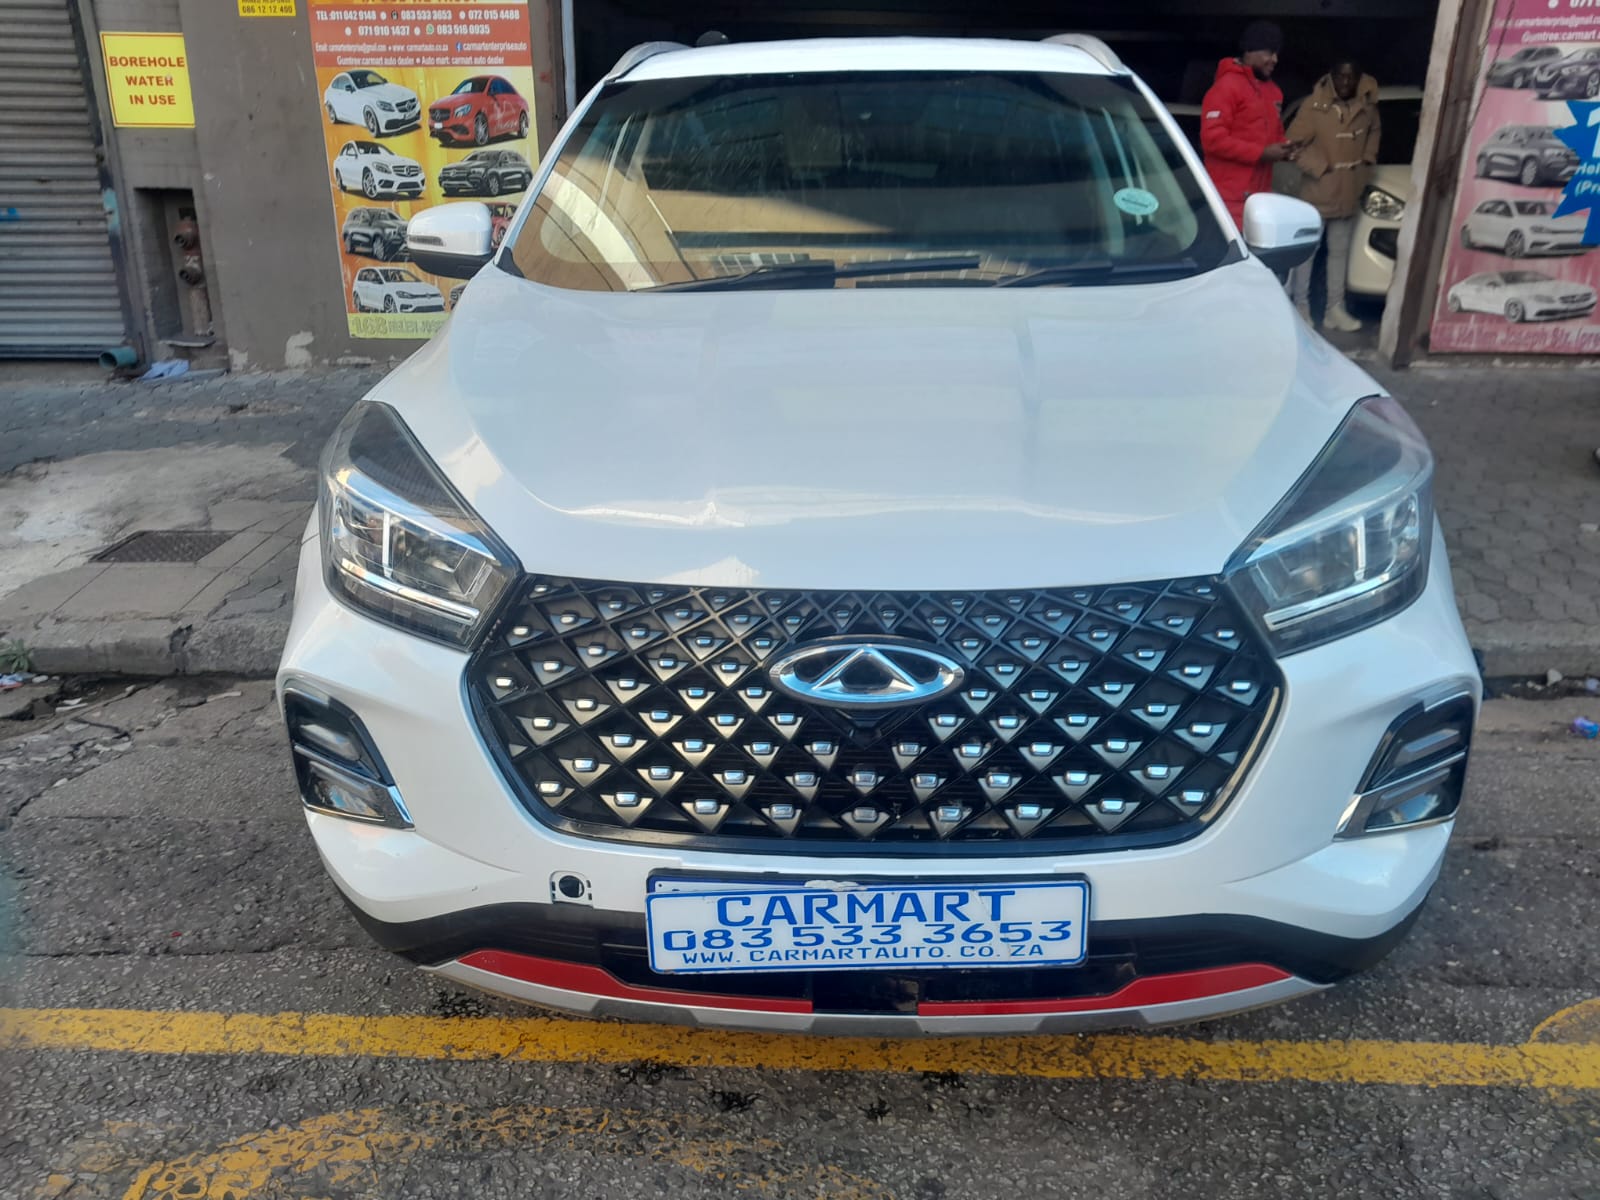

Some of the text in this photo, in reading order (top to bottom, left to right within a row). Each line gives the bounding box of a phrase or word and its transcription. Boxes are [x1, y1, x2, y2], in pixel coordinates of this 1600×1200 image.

[258, 5, 266, 14] 12
[269, 5, 278, 14] 12
[109, 55, 185, 68] BOREHOLE
[125, 75, 174, 87] WATER
[129, 94, 177, 105] IN USE
[717, 890, 1016, 927] CARMART
[663, 920, 1072, 951] 083 533 3653
